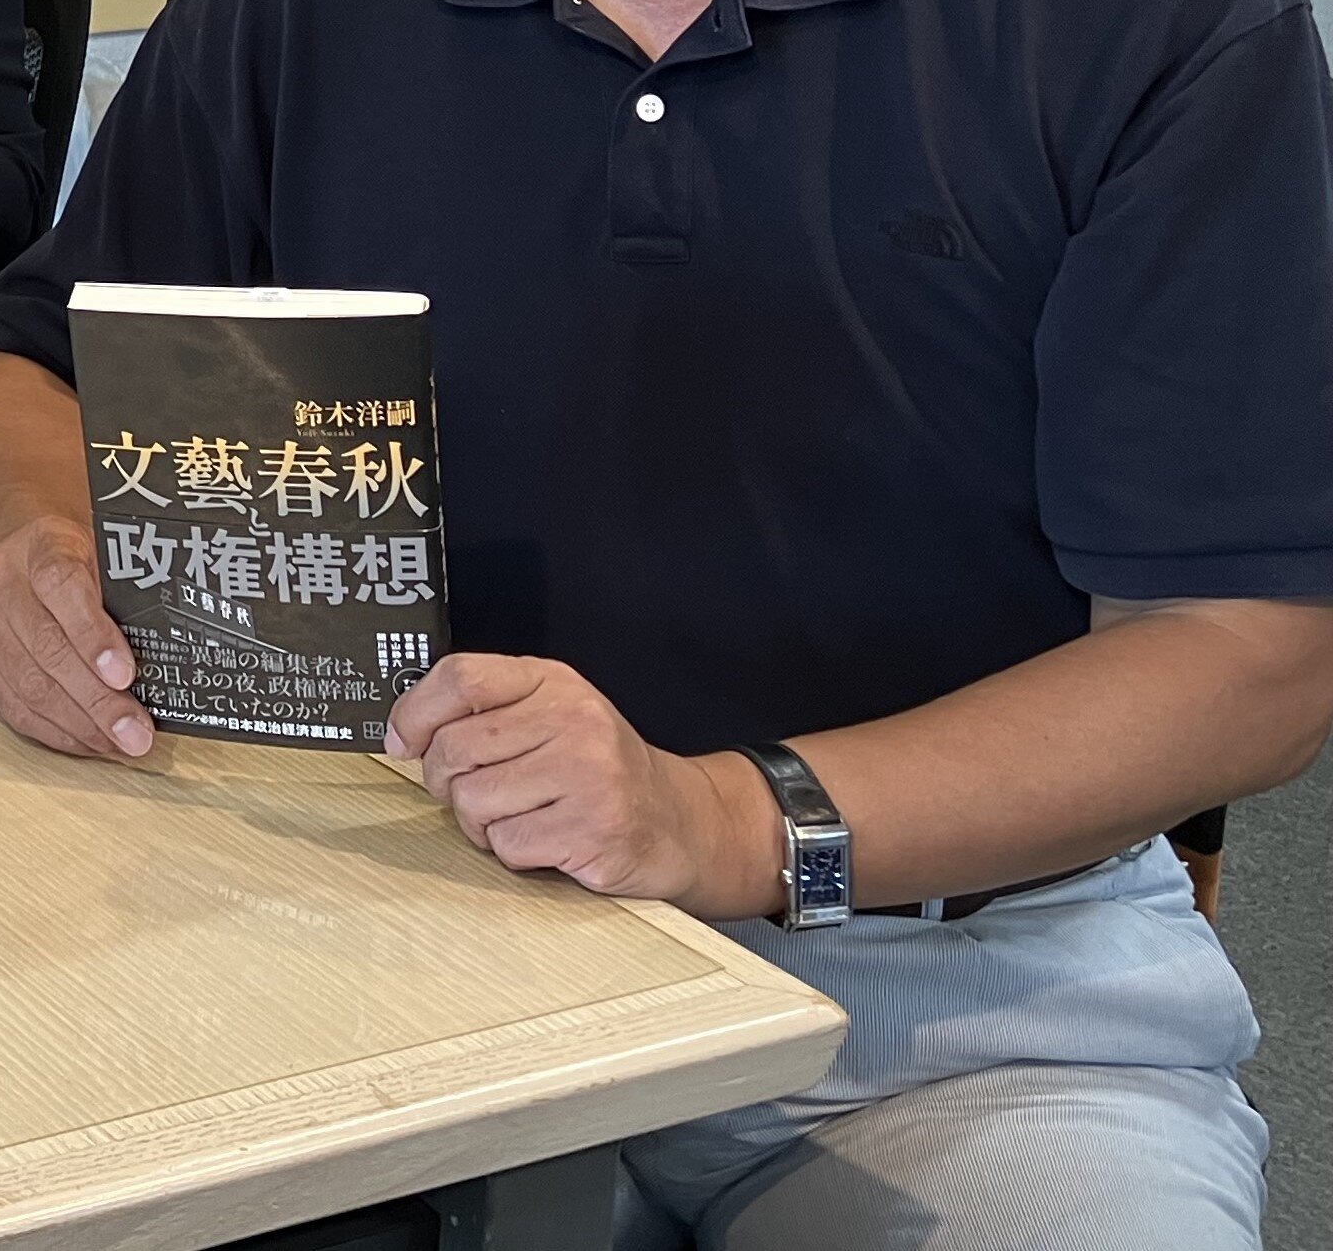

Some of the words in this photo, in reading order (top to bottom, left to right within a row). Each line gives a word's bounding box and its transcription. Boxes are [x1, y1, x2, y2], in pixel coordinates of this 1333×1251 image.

[295, 400, 416, 427] 鈴木洋嗣
[90, 431, 429, 519] 文藝春秋
[248, 507, 271, 537] と
[102, 521, 435, 606] 政権構想
[135, 664, 382, 701] の日、あの夜、政権幹部と
